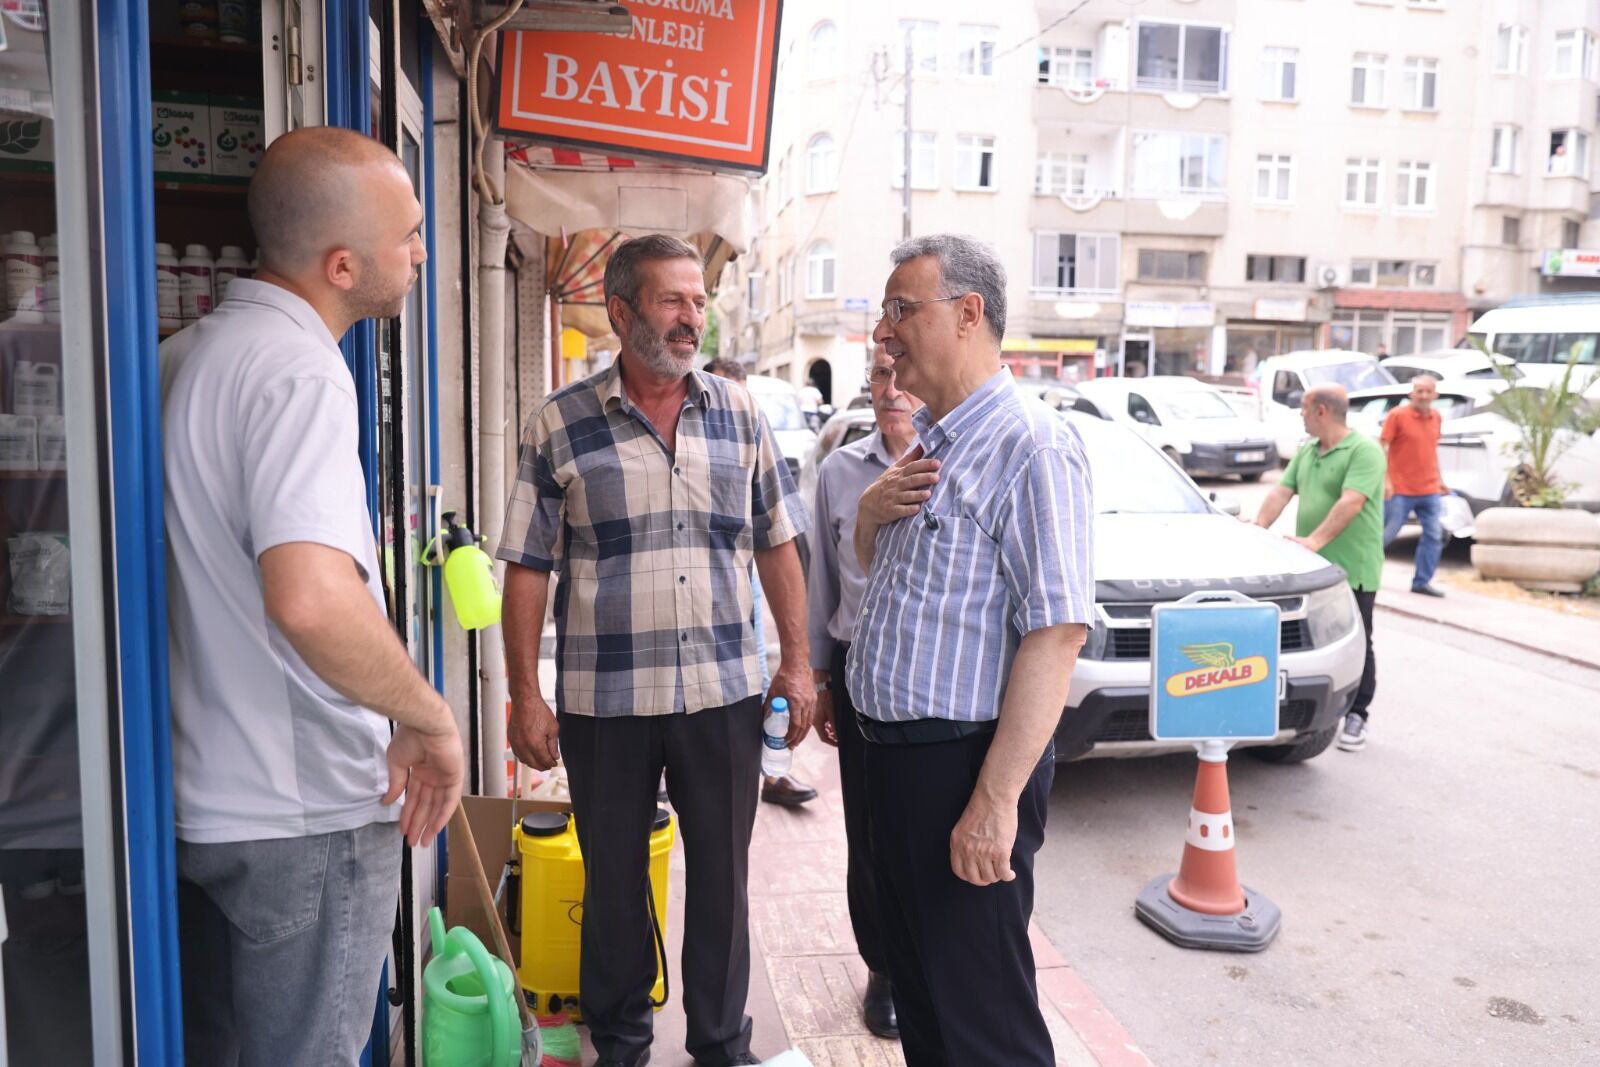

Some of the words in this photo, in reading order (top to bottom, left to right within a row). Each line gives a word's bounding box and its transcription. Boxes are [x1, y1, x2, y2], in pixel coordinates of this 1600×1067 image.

[630, 0, 735, 20] UMA
[598, 16, 705, 51] NLERİ
[540, 53, 733, 126] BAYİSİ
[1184, 665, 1253, 691] DEKALB
